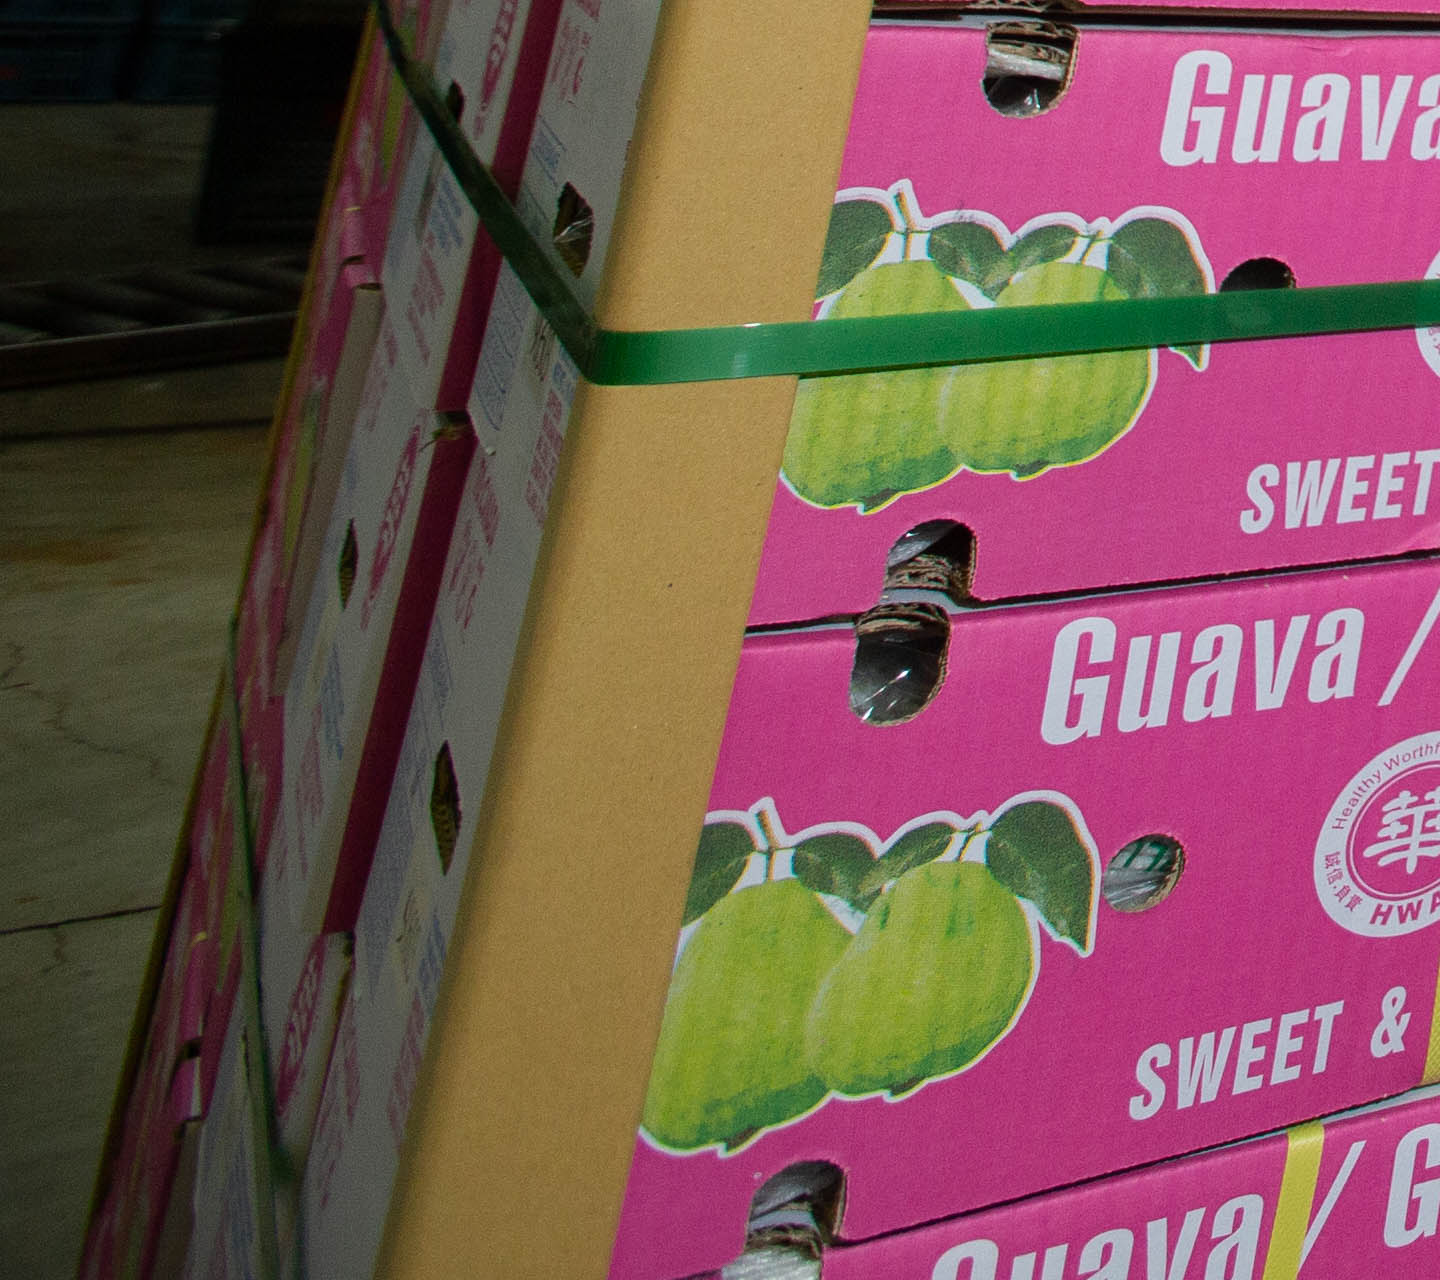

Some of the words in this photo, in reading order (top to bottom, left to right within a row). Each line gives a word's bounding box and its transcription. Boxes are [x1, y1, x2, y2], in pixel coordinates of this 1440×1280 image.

[1041, 608, 1364, 744] Guava
[1332, 770, 1382, 830] Healthy
[1130, 1001, 1344, 1120] SWEET
[1371, 986, 1410, 1057] &
